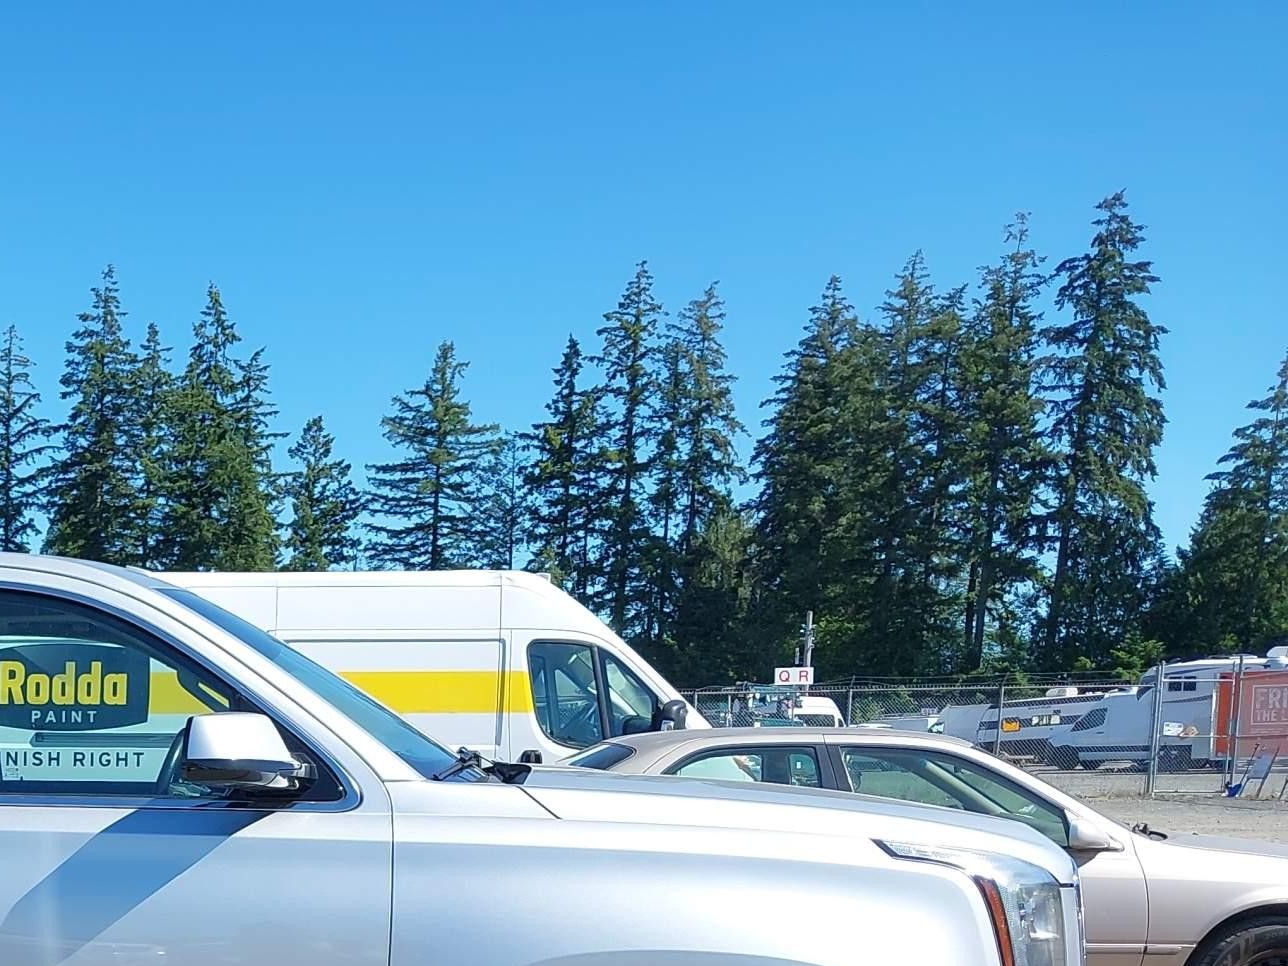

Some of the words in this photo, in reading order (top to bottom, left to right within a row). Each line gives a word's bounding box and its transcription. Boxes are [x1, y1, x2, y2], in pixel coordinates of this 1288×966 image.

[779, 670, 790, 682] Q
[799, 670, 809, 682] R
[31, 710, 97, 723] PAINT
[1255, 709, 1279, 721] THE
[5, 751, 61, 767] NISH
[72, 752, 145, 768] RIGHT
